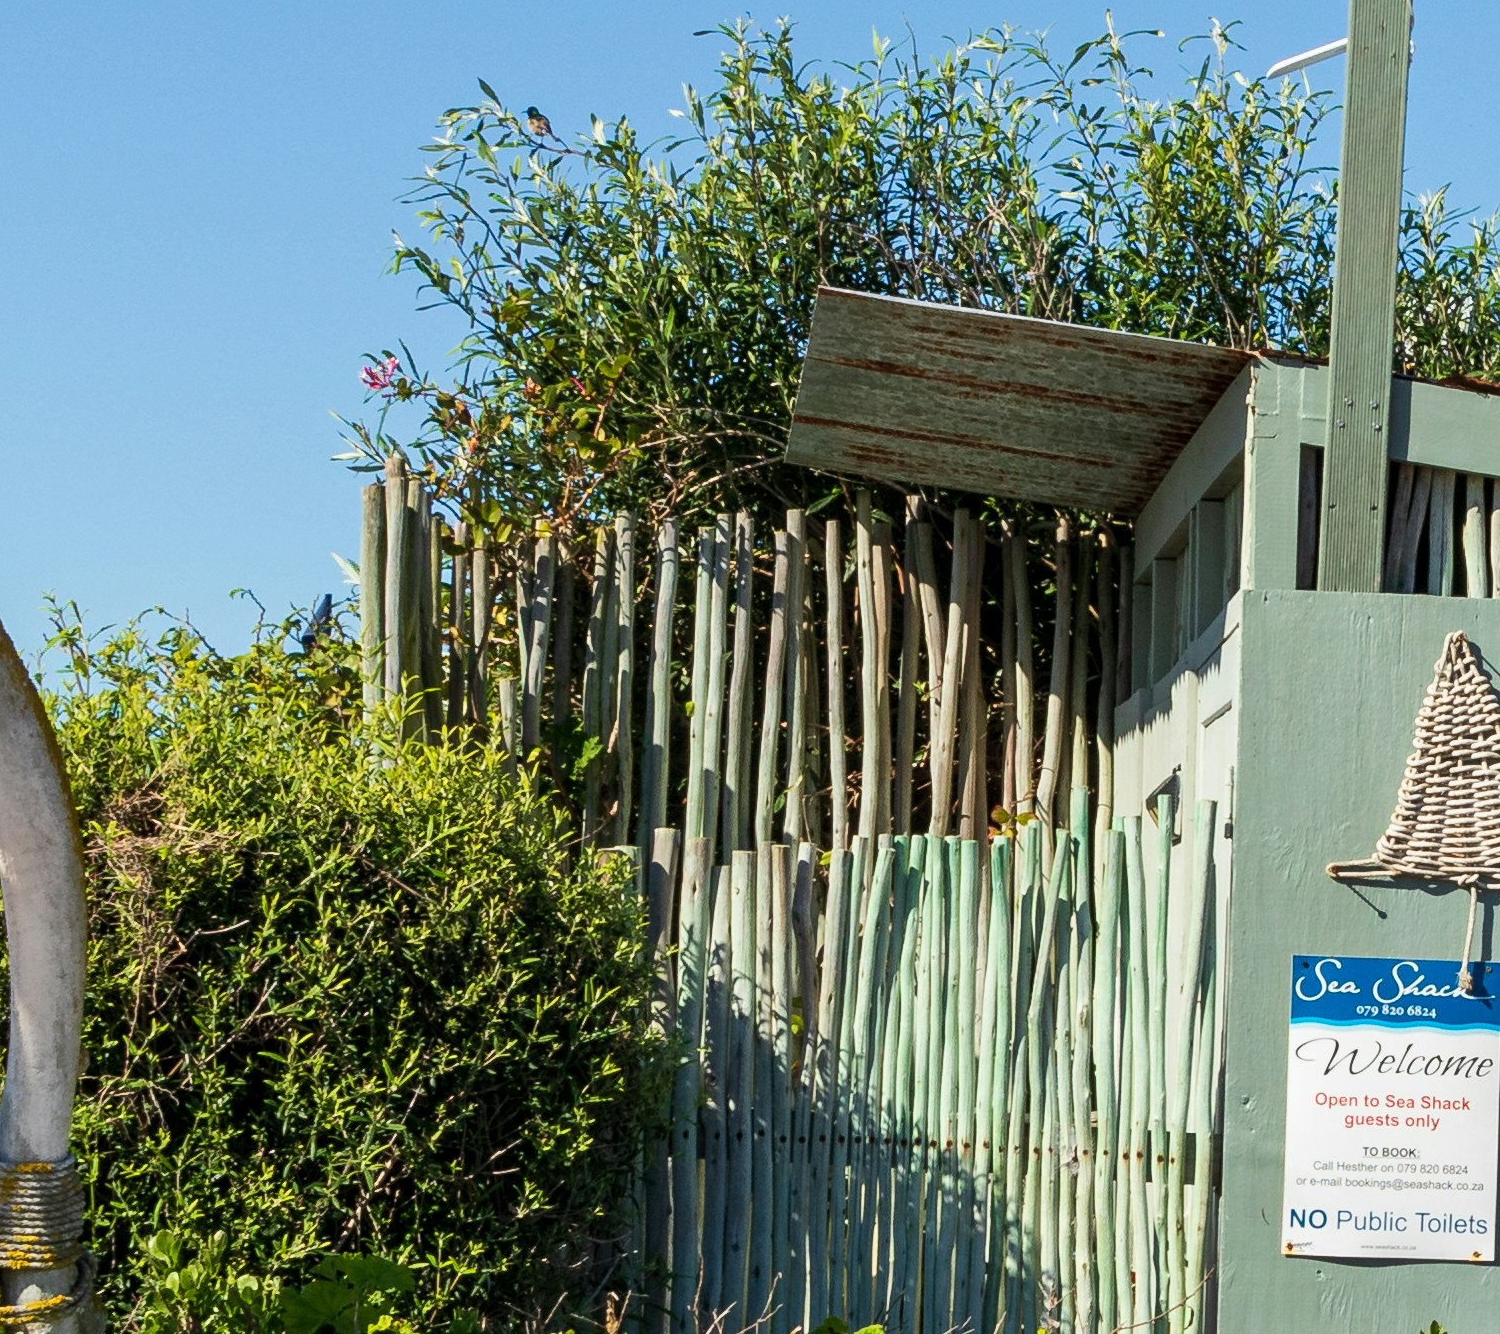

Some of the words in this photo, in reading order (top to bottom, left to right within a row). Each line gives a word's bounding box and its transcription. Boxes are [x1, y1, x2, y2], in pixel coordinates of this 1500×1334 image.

[1296, 958, 1360, 1001] Sea
[1356, 1005, 1381, 1017] 079
[1382, 1004, 1404, 1016] 820
[1407, 1005, 1437, 1018] 6824
[1296, 1037, 1494, 1078] Welcome
[1315, 1092, 1358, 1109] Open
[1364, 1094, 1380, 1108] to
[1385, 1095, 1415, 1109] Sea
[1421, 1096, 1470, 1111] Shack
[1345, 1114, 1399, 1128] guests
[1405, 1115, 1440, 1131] only
[1363, 1147, 1378, 1157] TO
[1382, 1148, 1420, 1158] BOOK:
[1313, 1161, 1333, 1171] Call
[1337, 1161, 1377, 1172] Hesther
[1381, 1165, 1393, 1173] on
[1397, 1164, 1416, 1173] 079
[1420, 1164, 1439, 1174] 820
[1443, 1165, 1468, 1175] 6824
[1310, 1177, 1342, 1187] e-mail
[1345, 1178, 1484, 1191] bookings@seashack.co.za
[1290, 1209, 1327, 1229] NO
[1337, 1210, 1407, 1232] Public
[1415, 1212, 1488, 1235] Toilets
